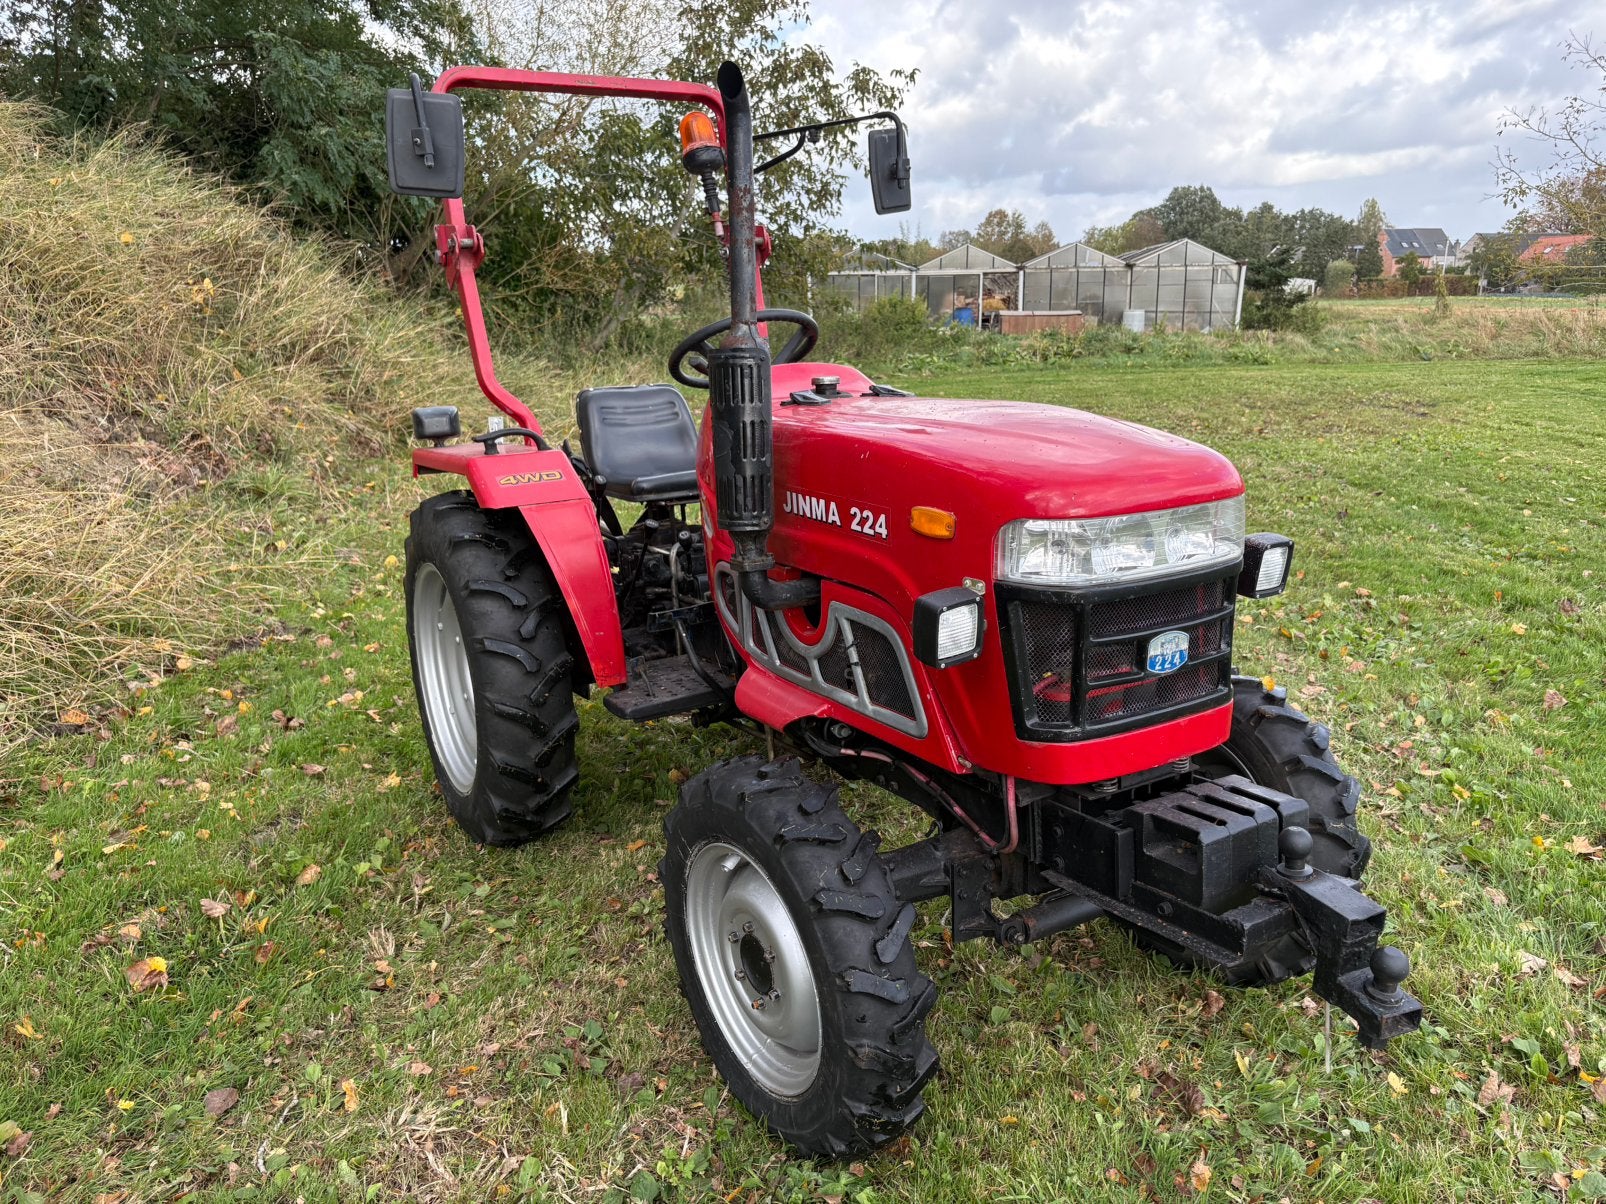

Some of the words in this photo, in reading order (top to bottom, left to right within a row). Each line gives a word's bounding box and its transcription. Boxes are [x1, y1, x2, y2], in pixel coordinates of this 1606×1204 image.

[499, 471, 562, 485] 4WD
[783, 491, 841, 526] JINMA
[850, 507, 888, 539] 224
[1155, 651, 1181, 670] 224
